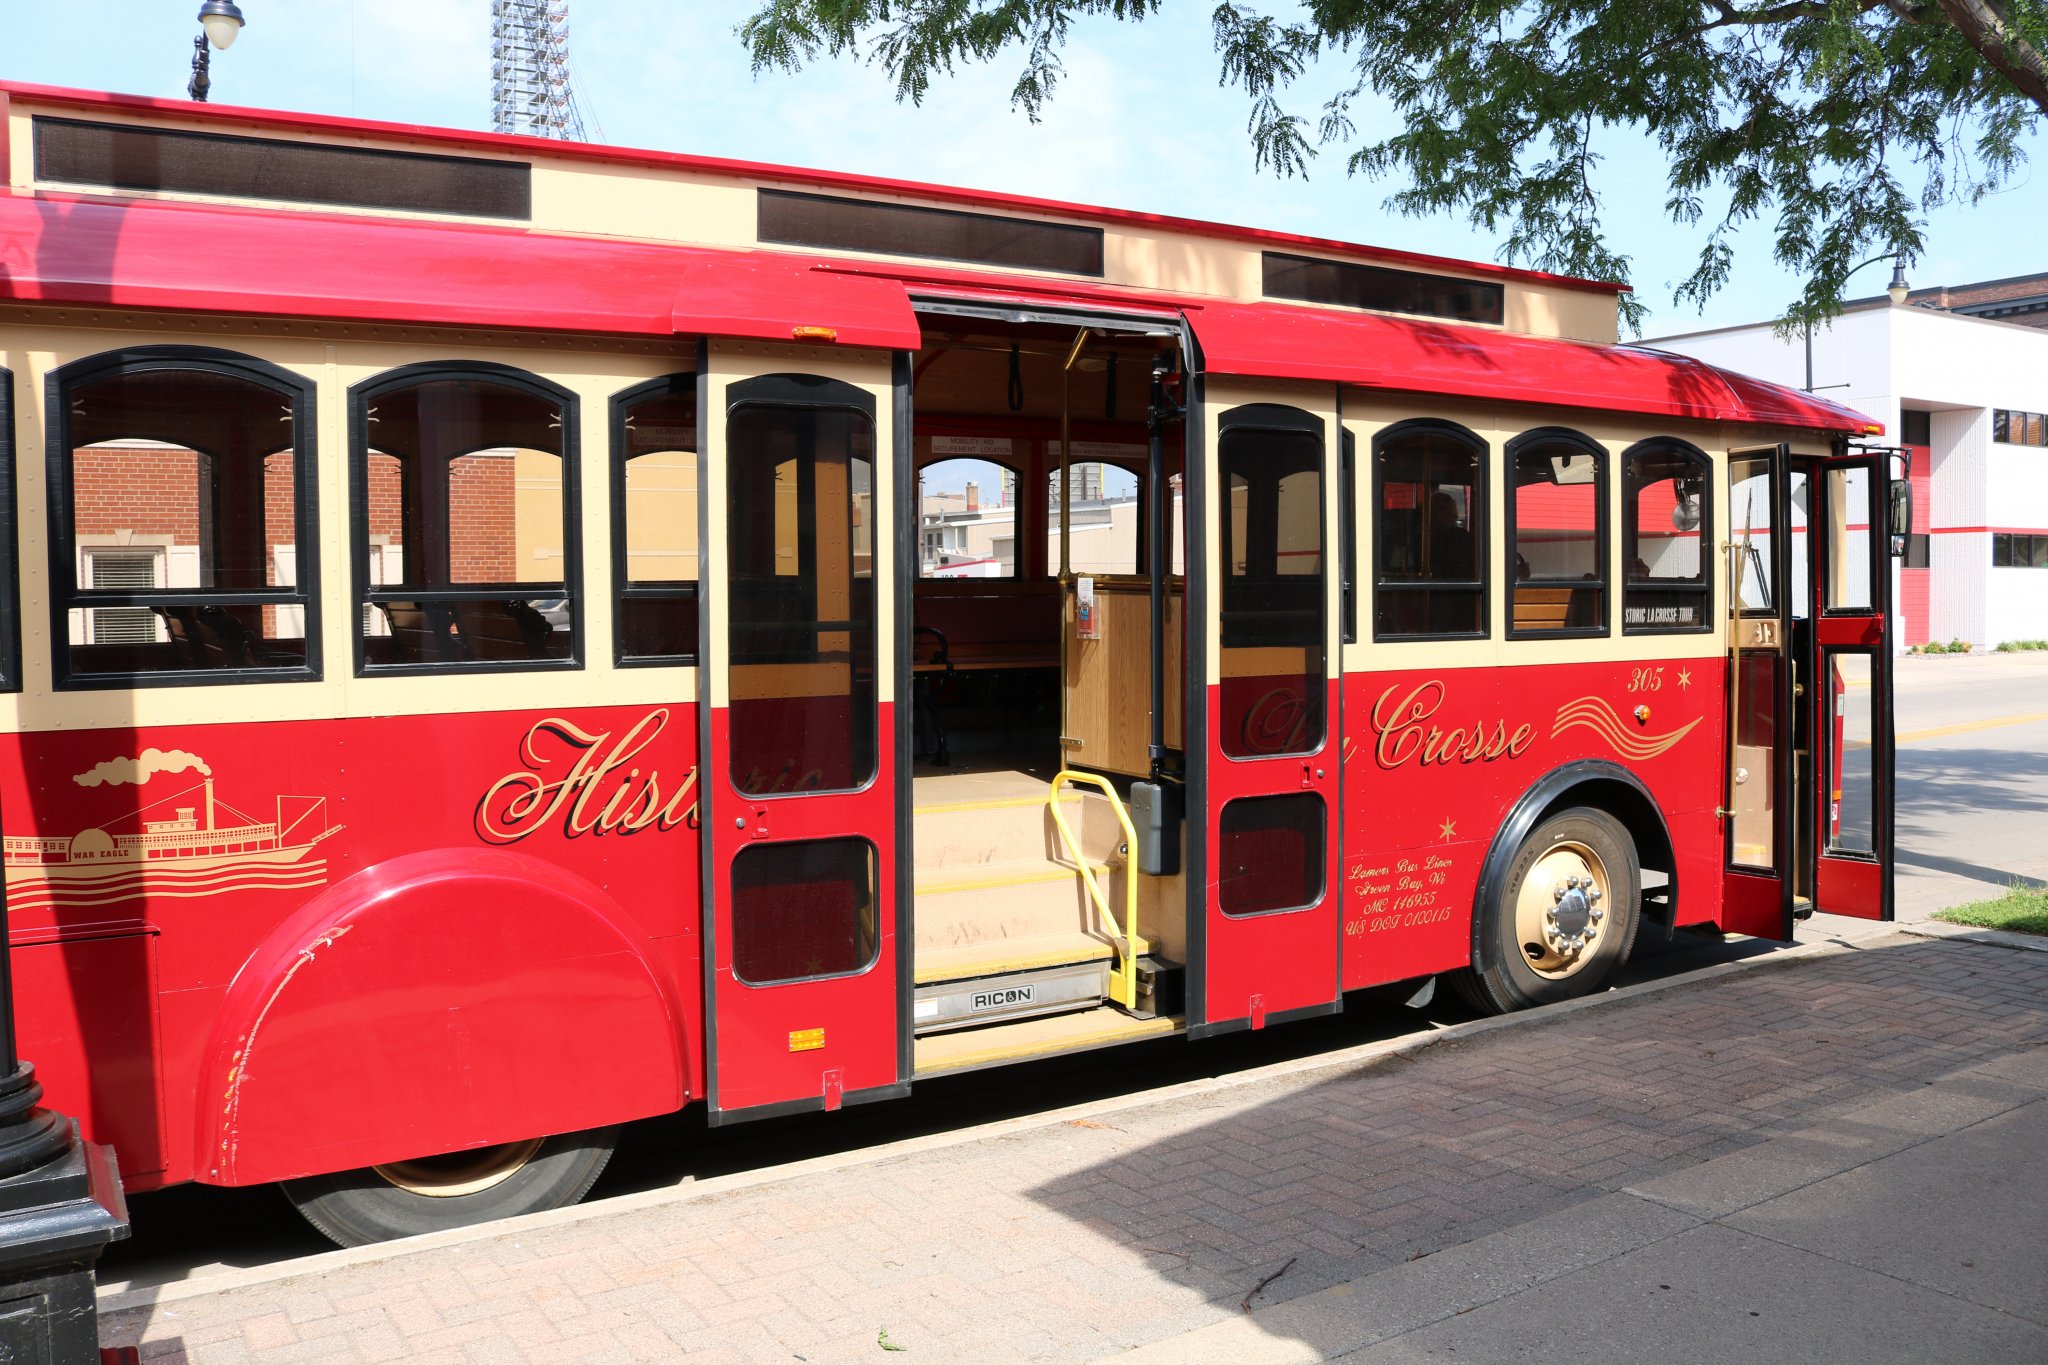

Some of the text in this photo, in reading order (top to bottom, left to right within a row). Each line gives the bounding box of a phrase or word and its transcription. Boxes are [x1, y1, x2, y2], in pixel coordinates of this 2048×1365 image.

[933, 445, 1011, 454] SECUREMENT LOCATION
[950, 437, 978, 445] MOBILITY
[1679, 607, 1694, 622] TOUR
[1627, 667, 1665, 692] 305
[1372, 680, 1537, 769] Crosse
[73, 850, 129, 859] WAR EAGLE
[1395, 859, 1418, 873] Bus
[1423, 855, 1453, 870] Lines
[1354, 881, 1391, 896] Green
[1396, 876, 1423, 891] Bay,
[1363, 891, 1437, 915] MC 146955
[1346, 906, 1452, 935] US DOT 0100115
[975, 988, 1031, 1008] RICON
